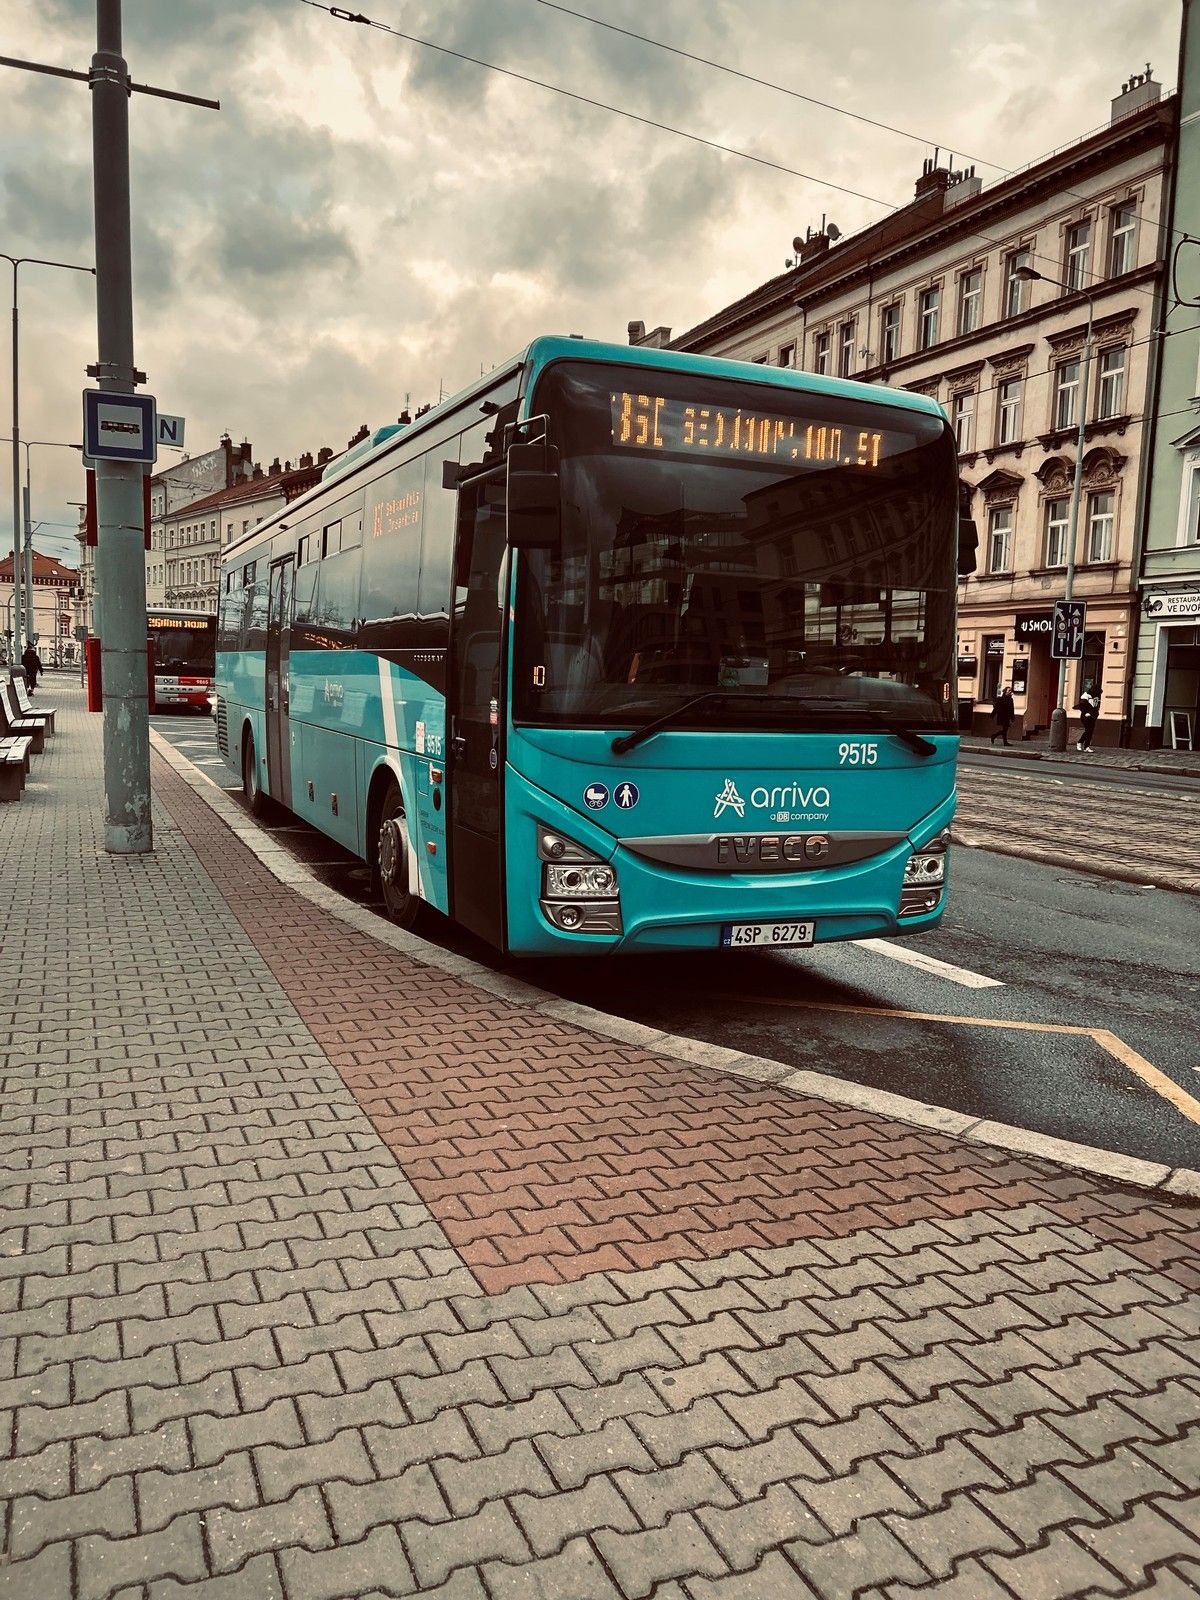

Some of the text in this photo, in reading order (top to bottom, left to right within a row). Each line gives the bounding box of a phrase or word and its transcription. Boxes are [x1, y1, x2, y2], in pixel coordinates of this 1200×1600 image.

[160, 419, 177, 441] N
[1167, 605, 1178, 613] VE
[838, 742, 878, 765] 9515
[751, 781, 830, 808] arriva
[791, 812, 830, 822] company
[717, 835, 829, 864] IVECO
[734, 927, 762, 944] 4SP
[772, 925, 807, 942] 6279
